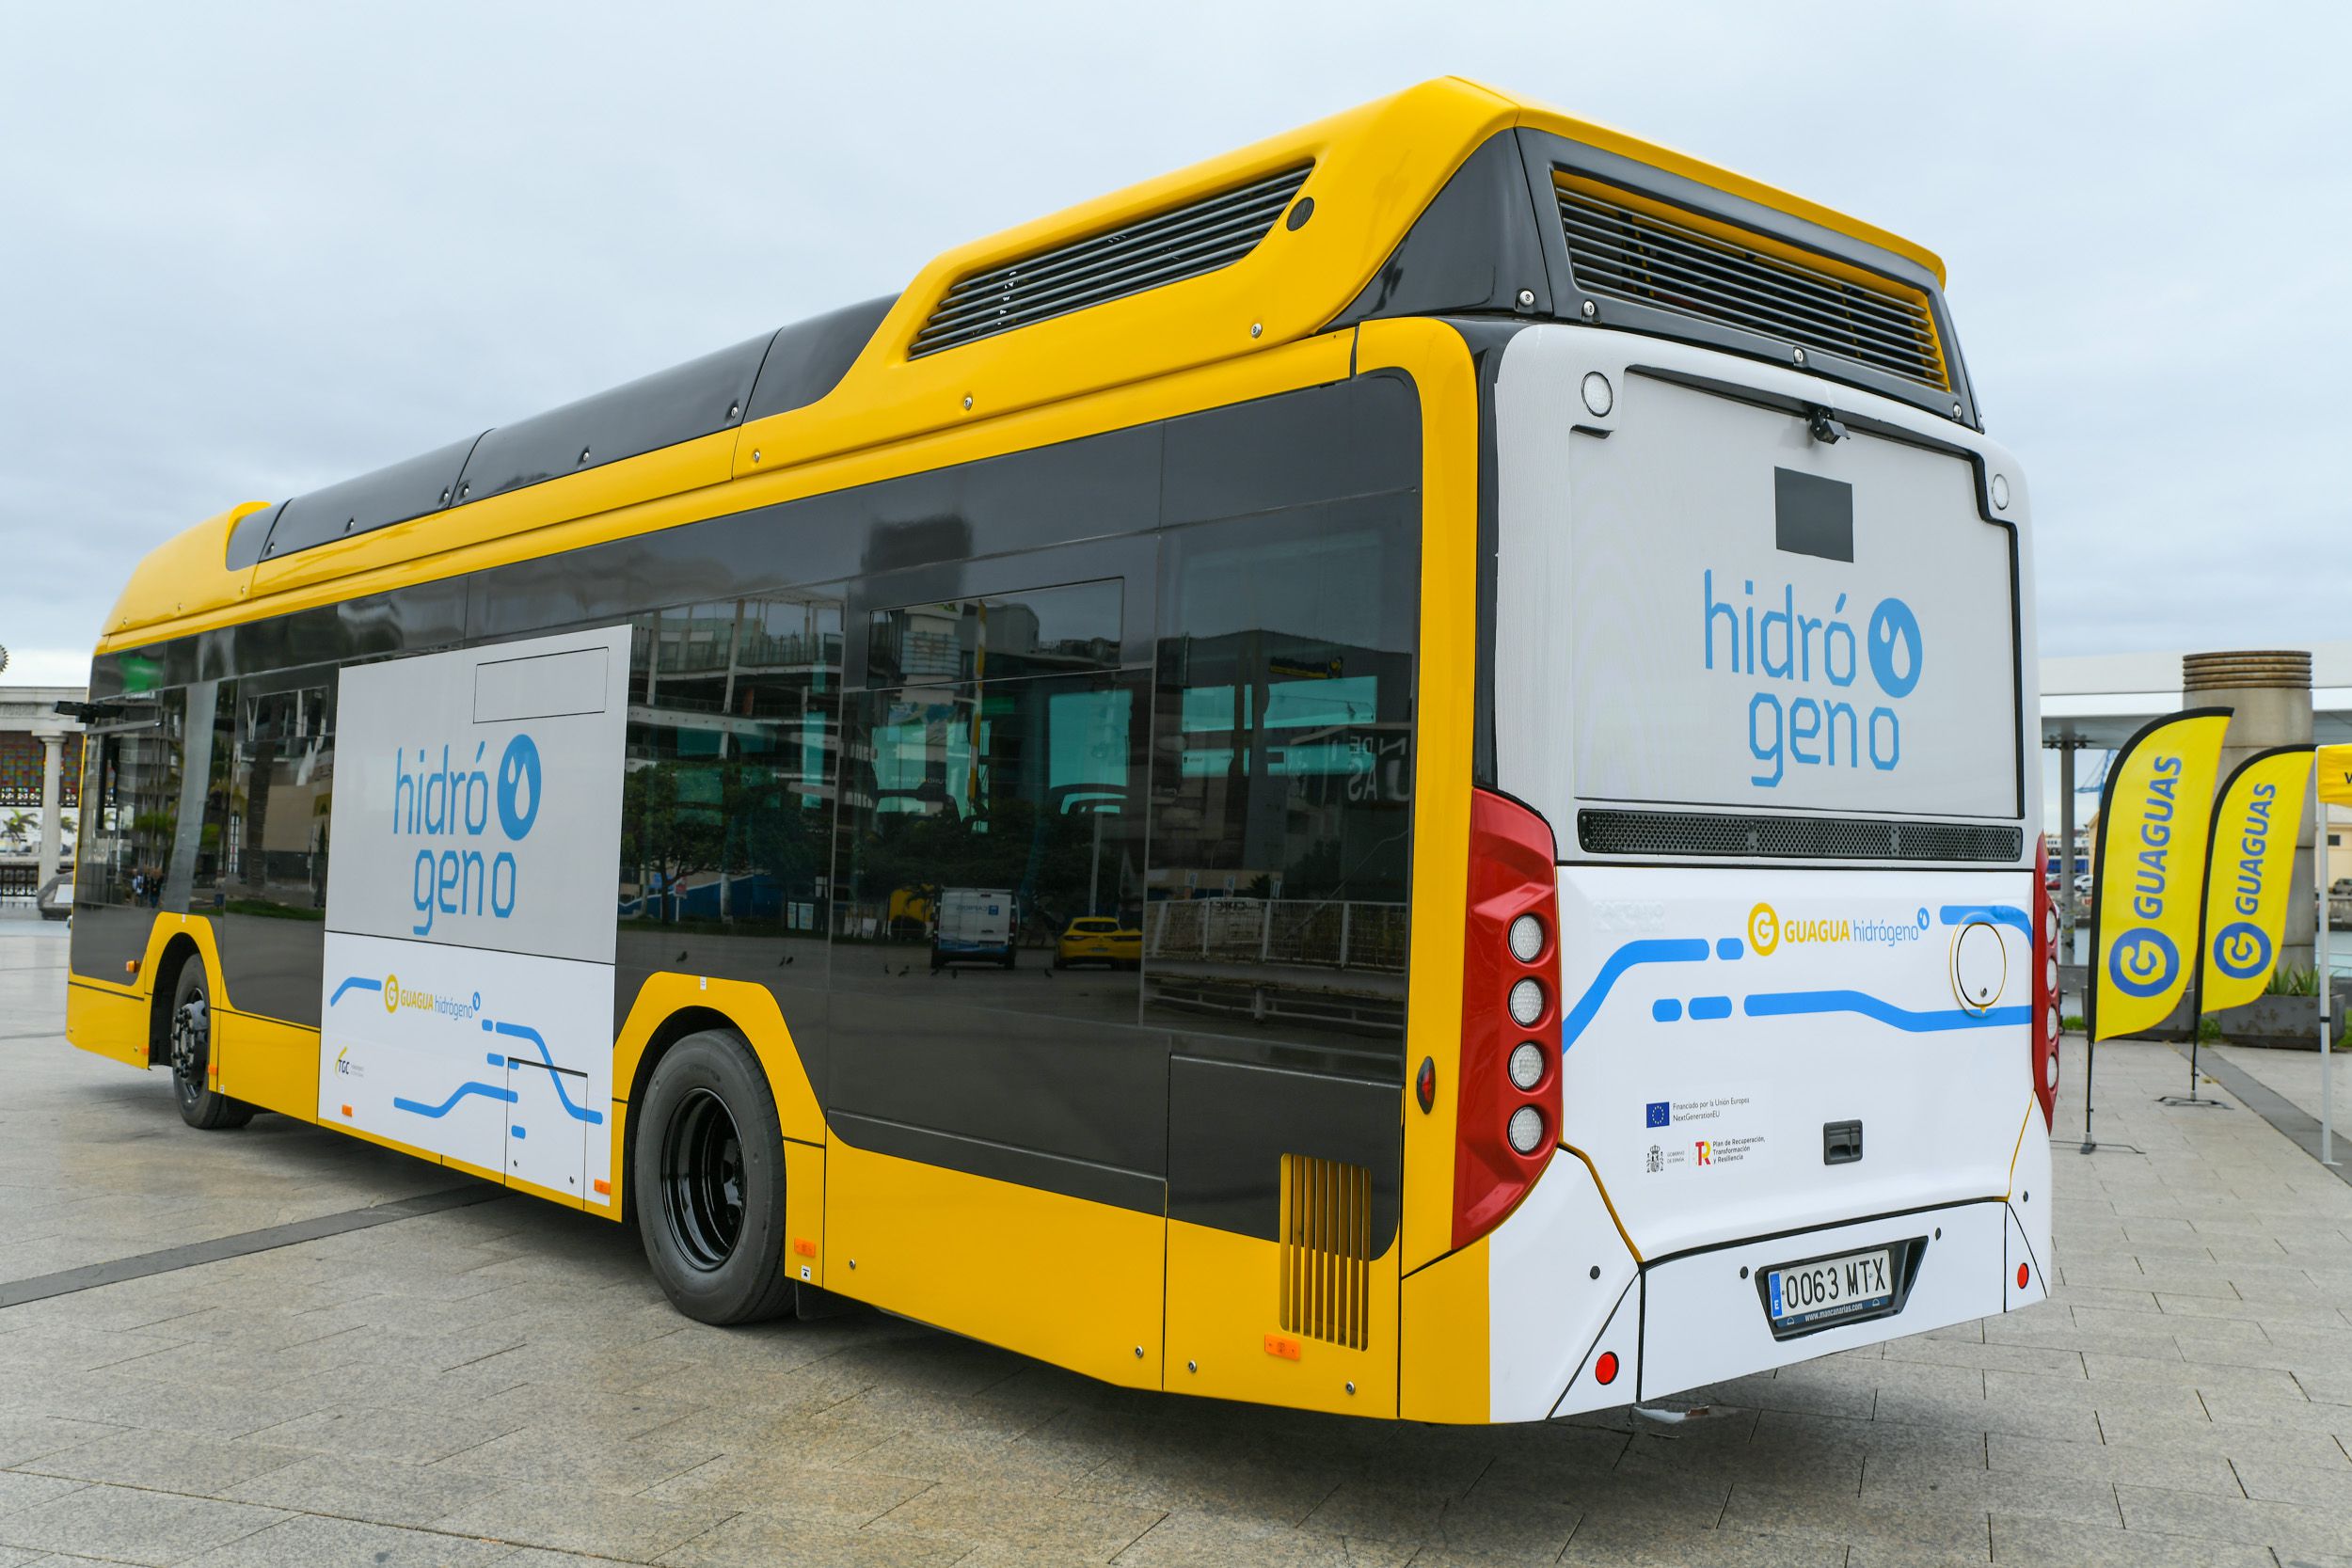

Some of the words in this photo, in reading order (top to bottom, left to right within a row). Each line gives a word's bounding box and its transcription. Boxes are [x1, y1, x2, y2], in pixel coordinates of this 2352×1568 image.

[1704, 568, 1856, 687] hidró
[1749, 692, 1899, 787] geno
[393, 740, 488, 835] hidró
[2134, 755, 2182, 920] GUAGUAS
[2234, 783, 2276, 915] GUAGUAS
[413, 849, 516, 936] geno
[1784, 920, 1851, 943] GUAGUA
[1853, 919, 1919, 947] hidrógeno
[400, 990, 434, 1009] GUAGUA
[435, 995, 473, 1021] hidrógeno
[338, 1060, 350, 1074] TGC
[1673, 1102, 1699, 1111] Financiado
[1699, 1101, 1708, 1110] por
[1715, 1099, 1730, 1107] Unión
[1730, 1097, 1750, 1106] Europea
[1673, 1111, 1721, 1122] NextGenerationEU
[1713, 1146, 1751, 1155] Transformación
[1717, 1154, 1743, 1163] Resiliencia
[1786, 1266, 1839, 1309] 0063
[1845, 1257, 1886, 1297] MTX
[1773, 1299, 1780, 1310] E
[1804, 1303, 1863, 1322] www.mancanarias.com
